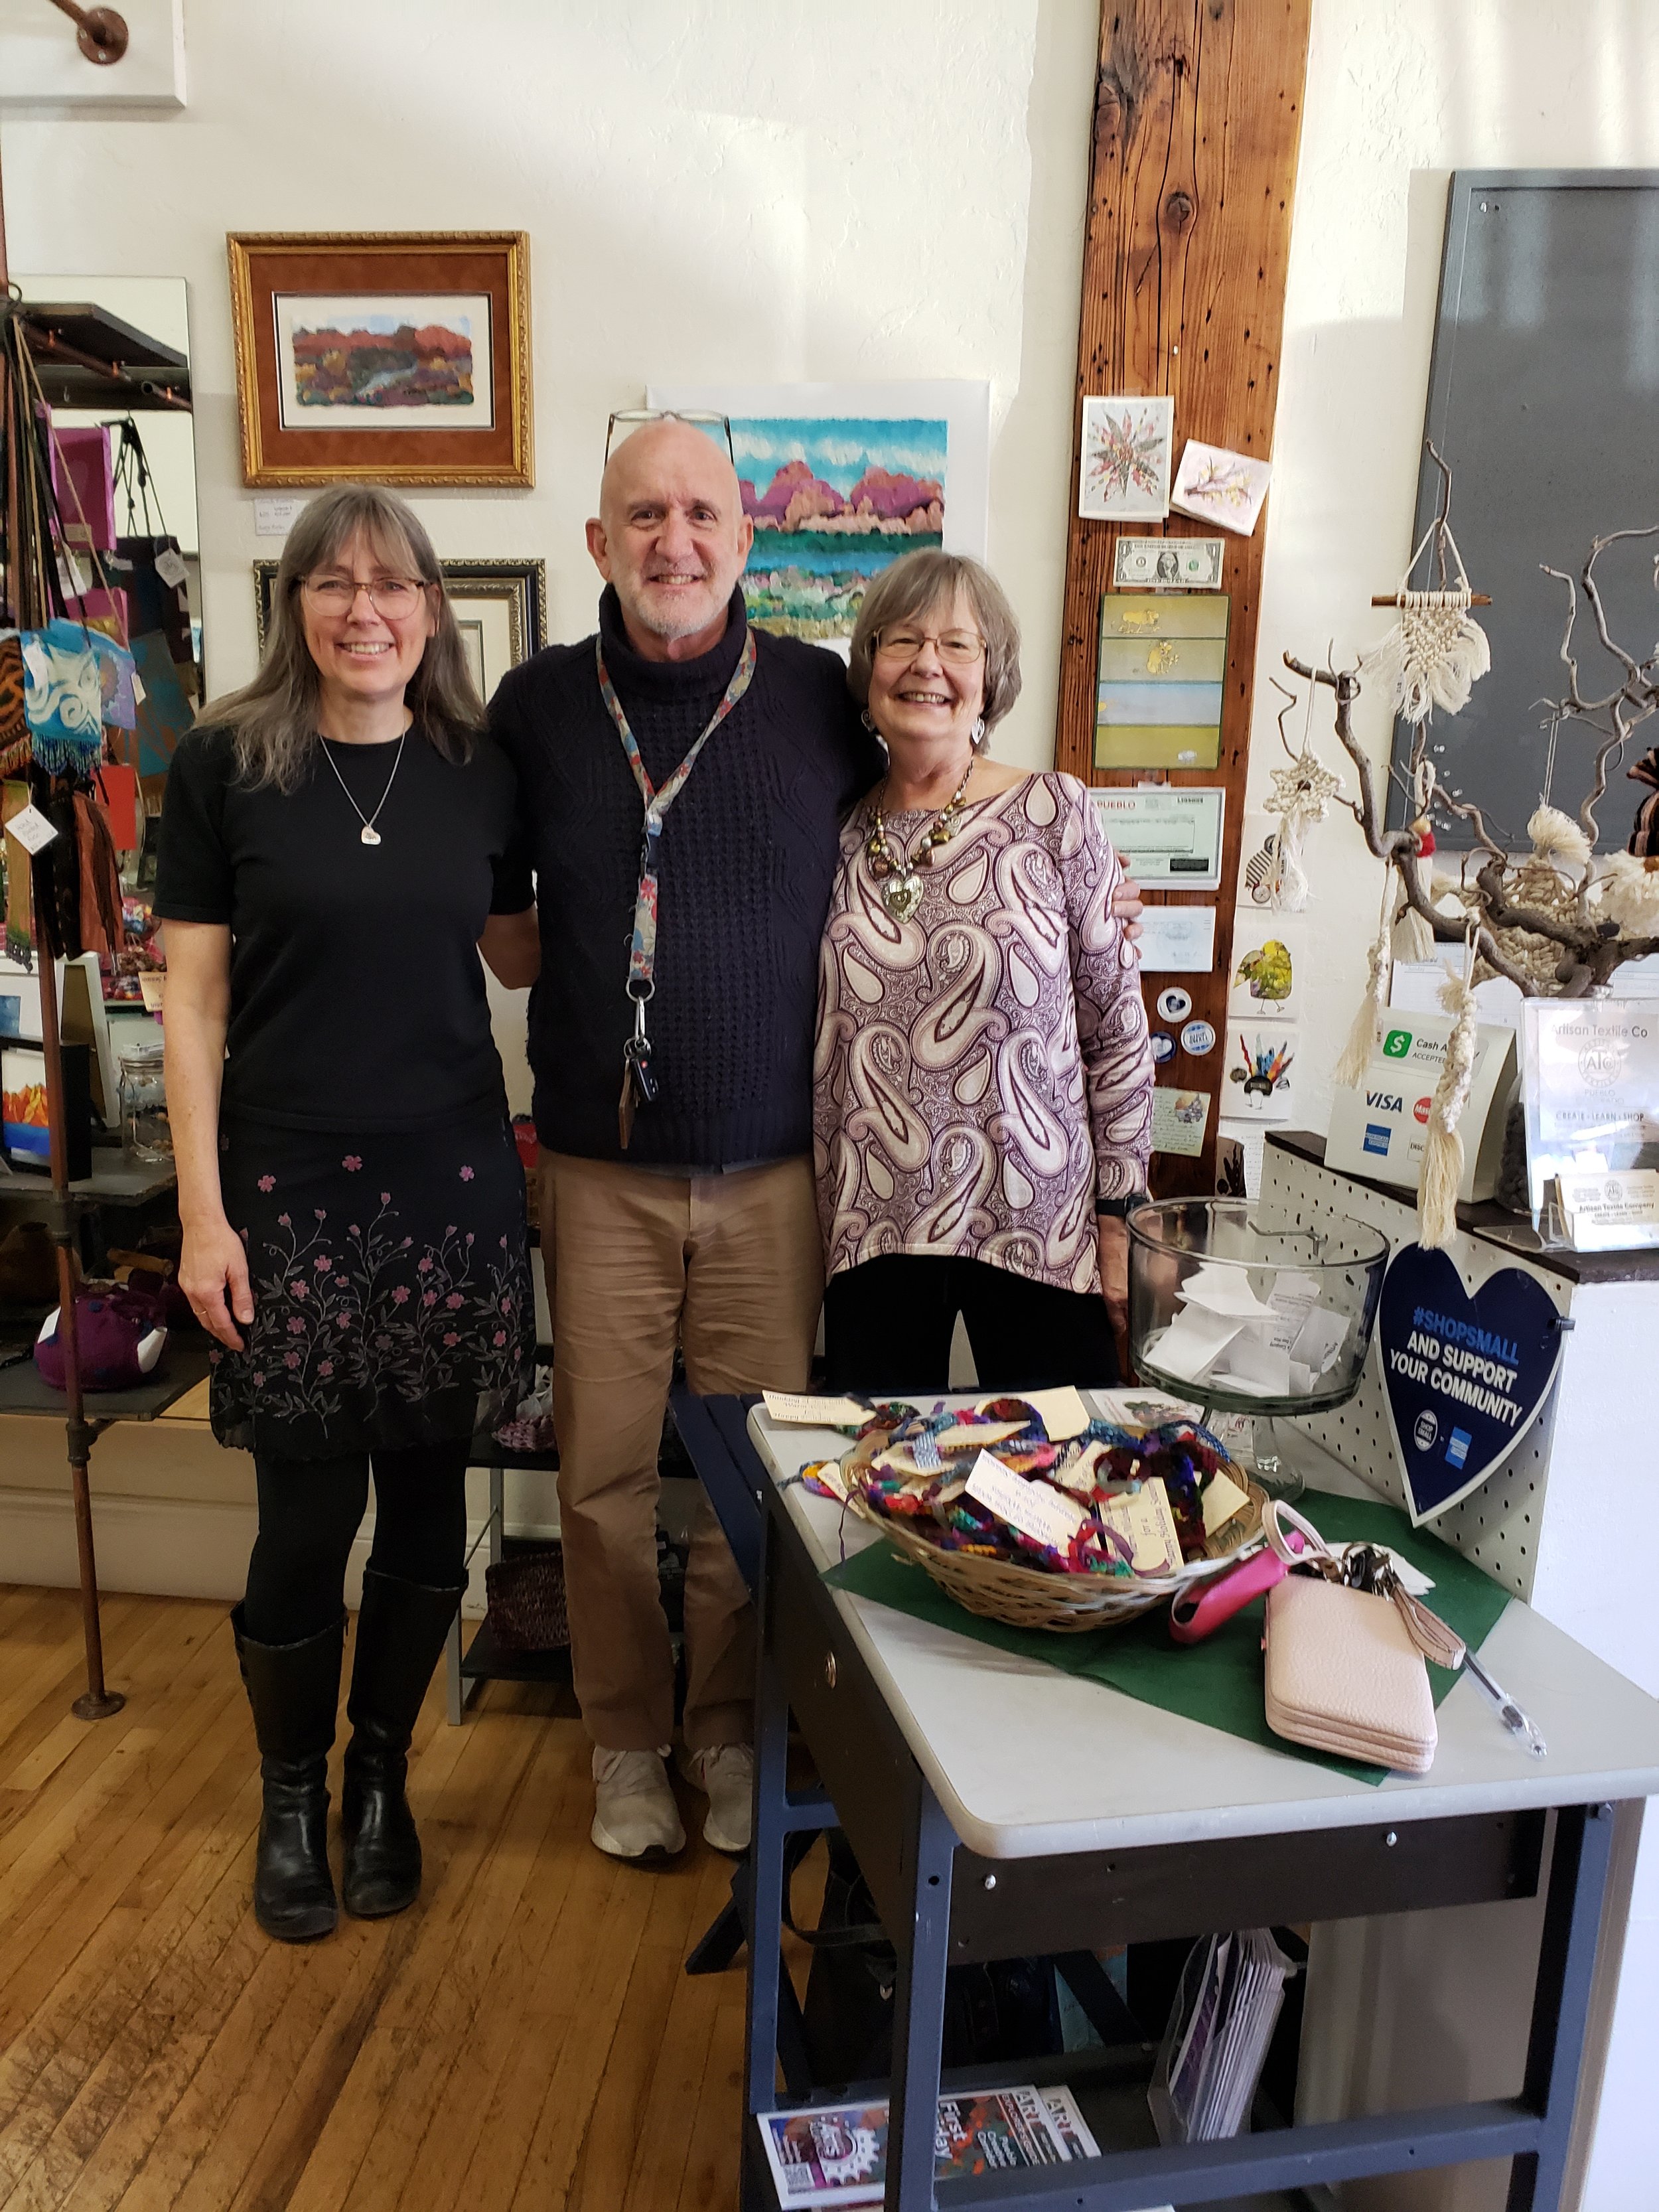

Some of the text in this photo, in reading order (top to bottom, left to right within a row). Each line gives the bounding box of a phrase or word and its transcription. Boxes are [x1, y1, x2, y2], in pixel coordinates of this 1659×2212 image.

[1593, 1024, 1628, 1037] Textile
[1632, 1025, 1648, 1038] Co
[1416, 1038, 1439, 1051] Cash
[1366, 1090, 1403, 1113] VISA
[1623, 1112, 1644, 1122] SHOP
[1410, 1142, 1425, 1152] DISC
[1413, 1306, 1519, 1366] #SHOPSMALL
[1407, 1330, 1518, 1394] AND SUPPORT
[1390, 1348, 1429, 1384] YOUR
[1430, 1366, 1523, 1428] COMMUNITY
[1417, 1427, 1432, 1441] SMALL
[1420, 1420, 1433, 1432] SHOP
[940, 2101, 968, 2142] First
[999, 2135, 1017, 2167] Pueblo
